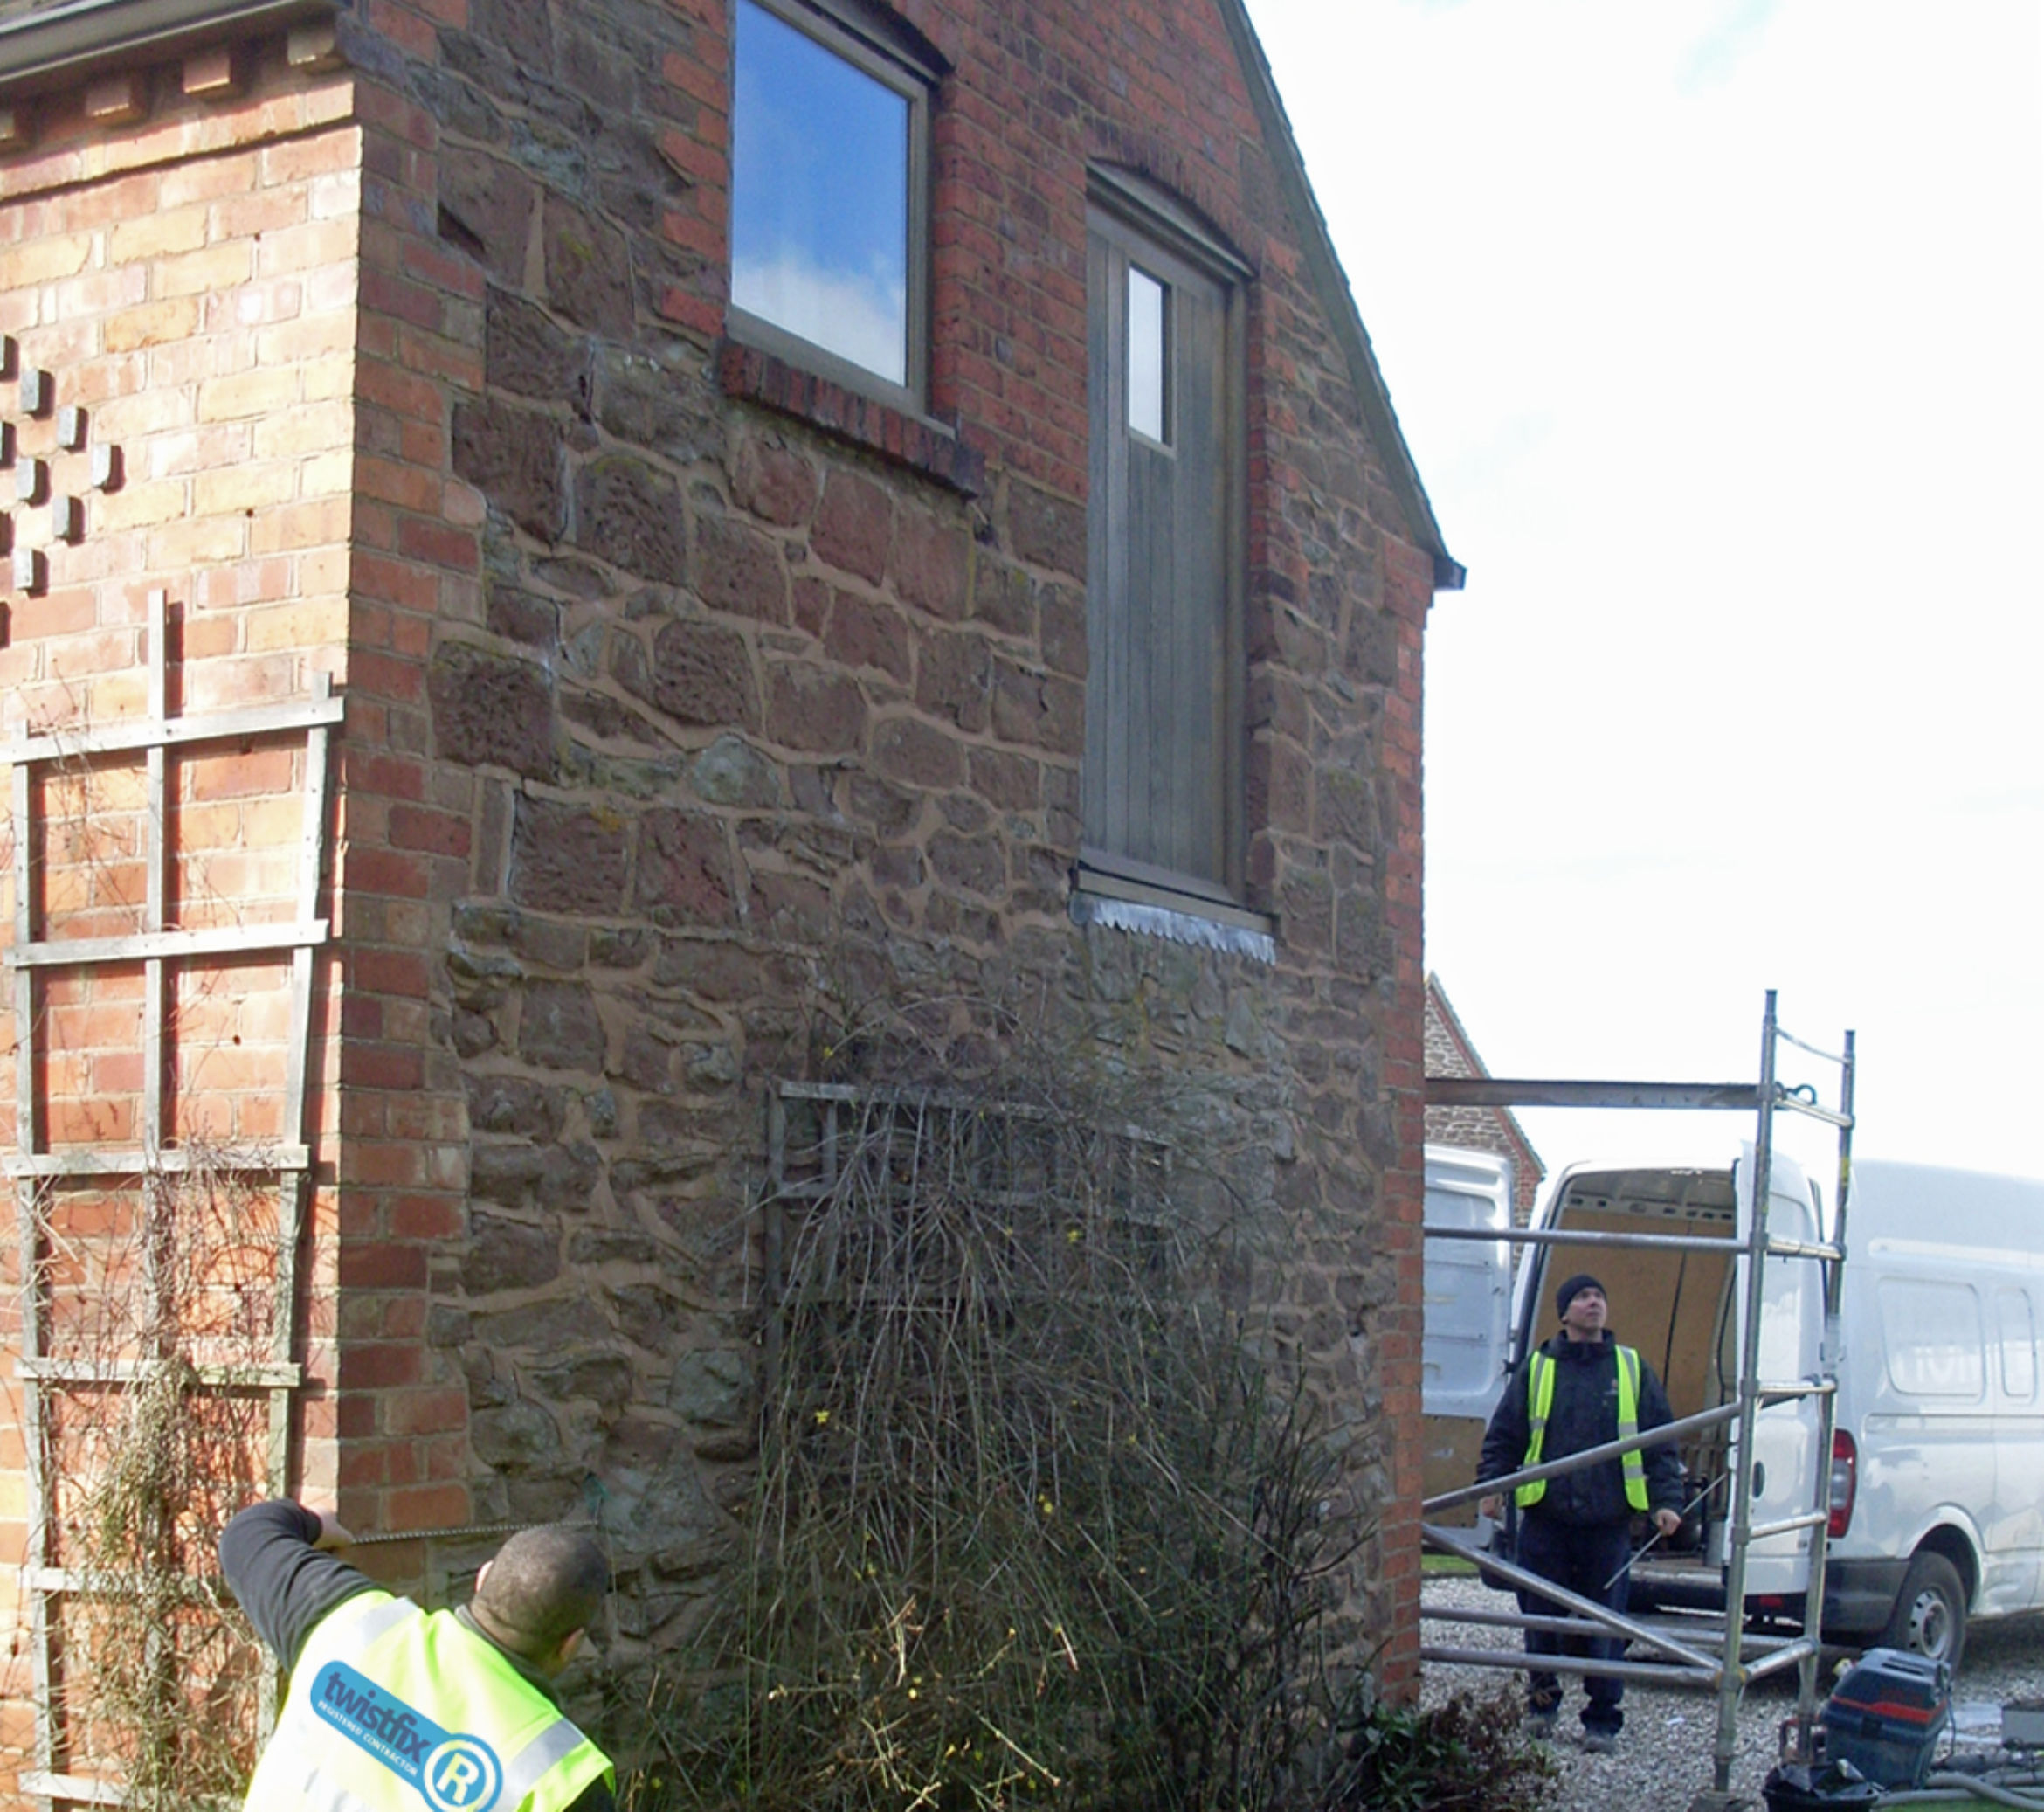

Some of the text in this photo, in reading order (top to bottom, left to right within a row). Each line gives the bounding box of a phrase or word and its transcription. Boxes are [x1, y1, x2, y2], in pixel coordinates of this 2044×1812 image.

[317, 1700, 418, 1778] REGISTERED CONTRACTOR
[324, 1671, 432, 1765] twistfix
